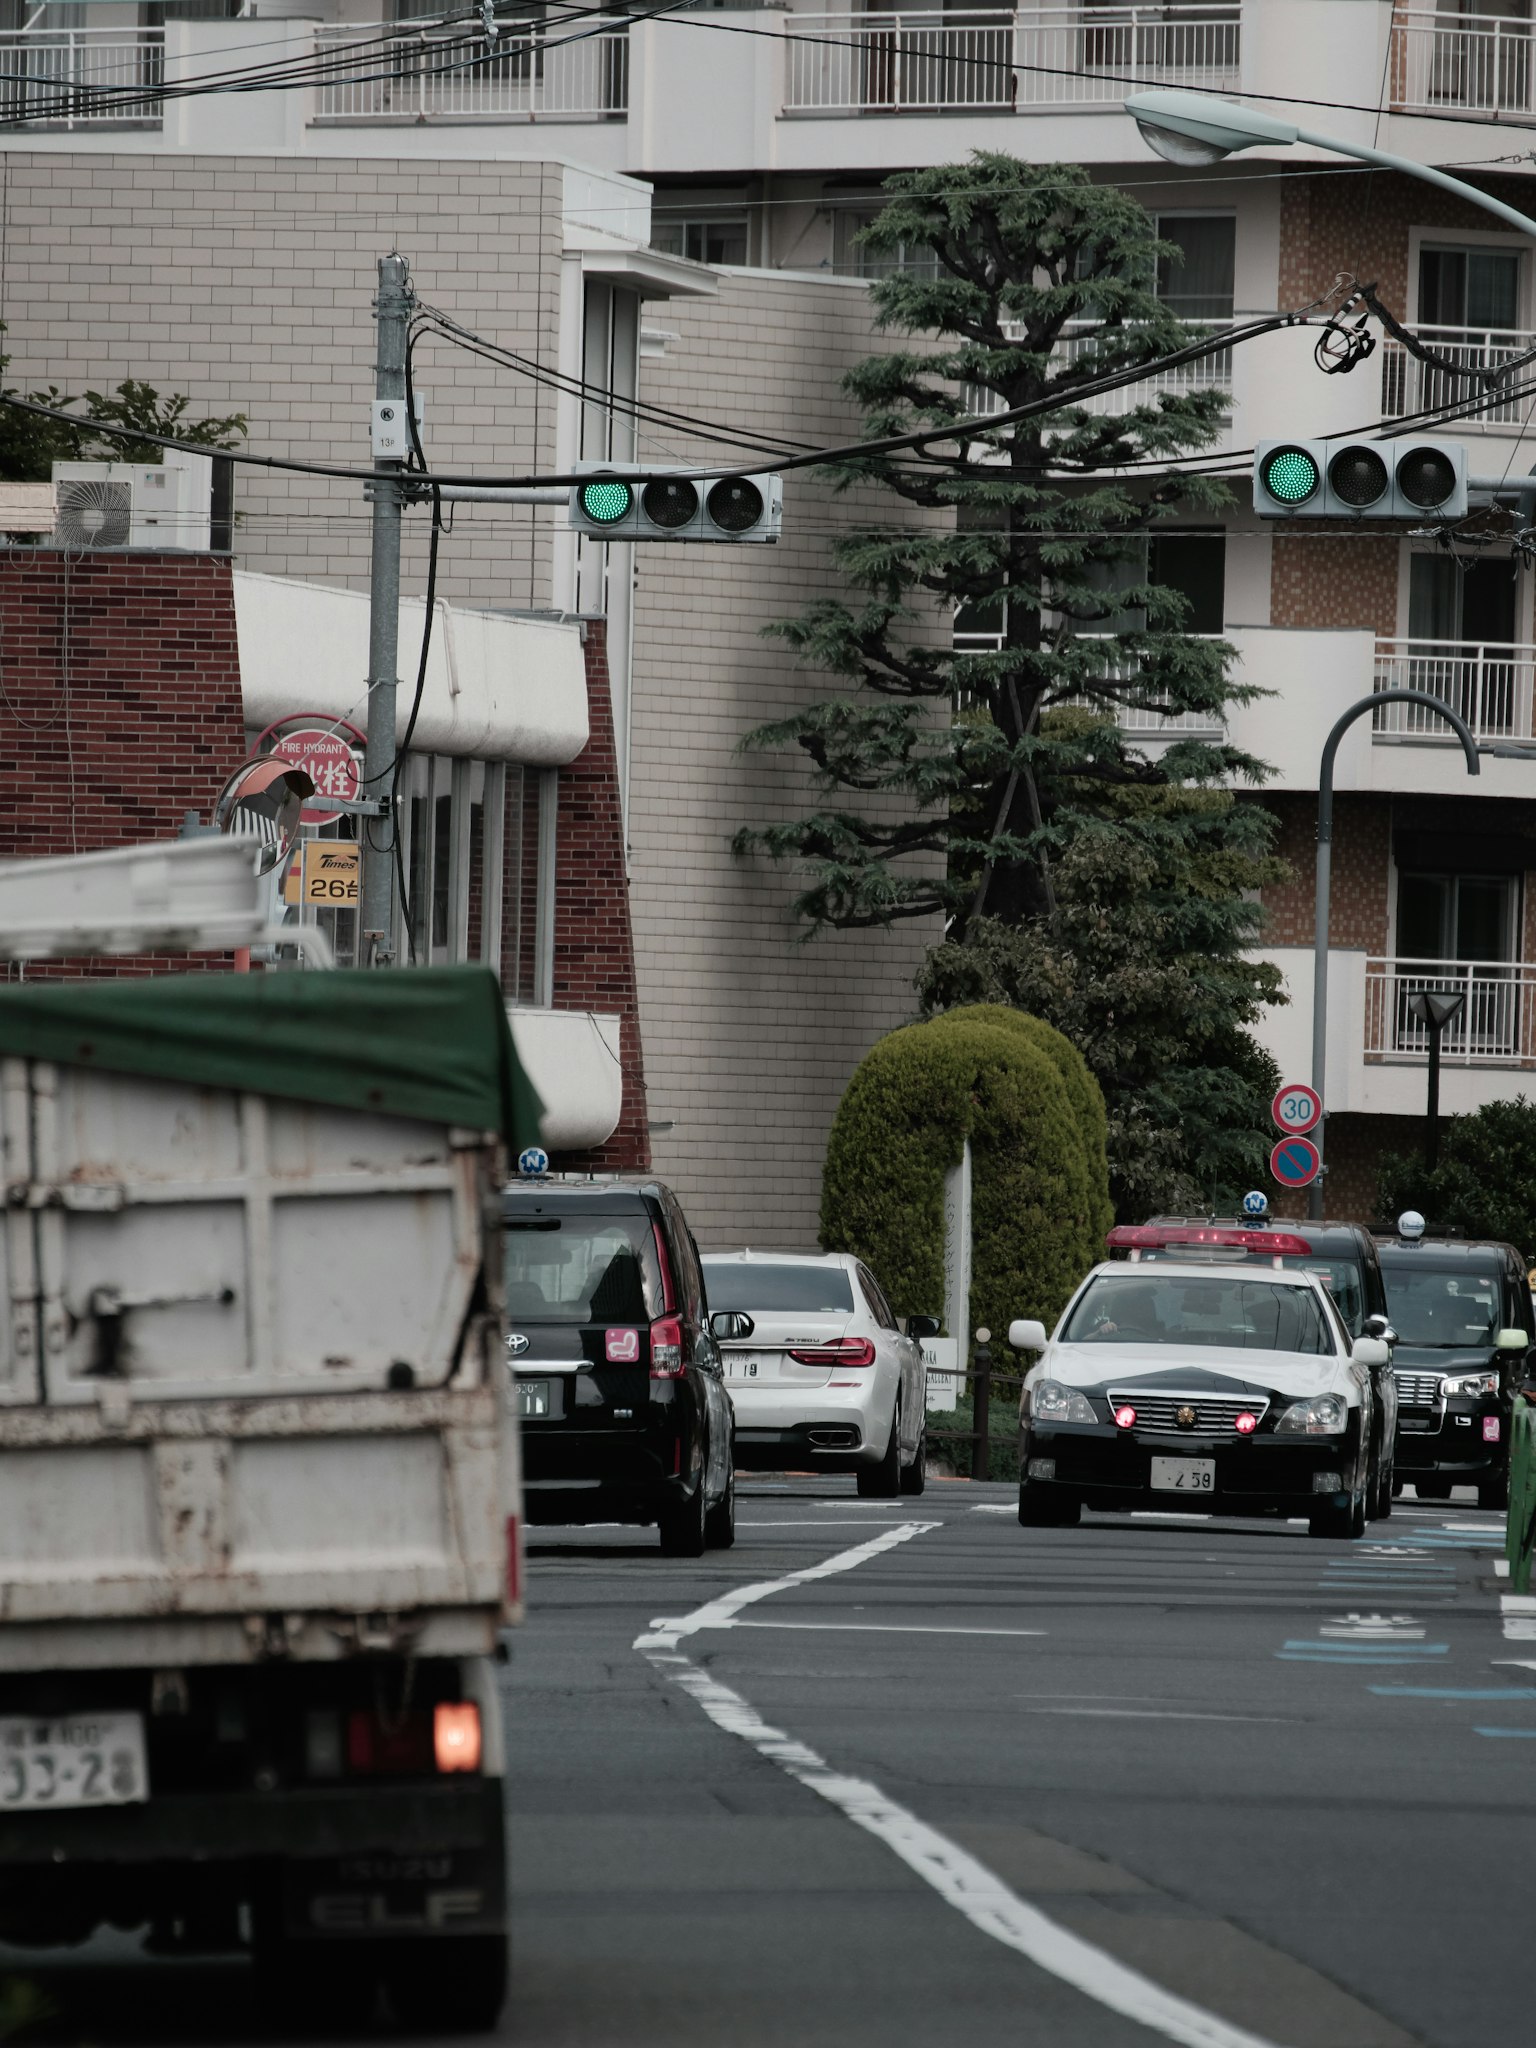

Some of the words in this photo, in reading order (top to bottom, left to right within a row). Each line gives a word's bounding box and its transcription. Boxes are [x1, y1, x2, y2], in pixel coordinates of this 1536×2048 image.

[282, 743, 300, 753] FIRE
[303, 743, 343, 754] HYDRANT
[289, 760, 352, 796] 火栓
[320, 854, 358, 869] Times
[1284, 1099, 1310, 1119] 30
[310, 1888, 483, 1928] ELF
